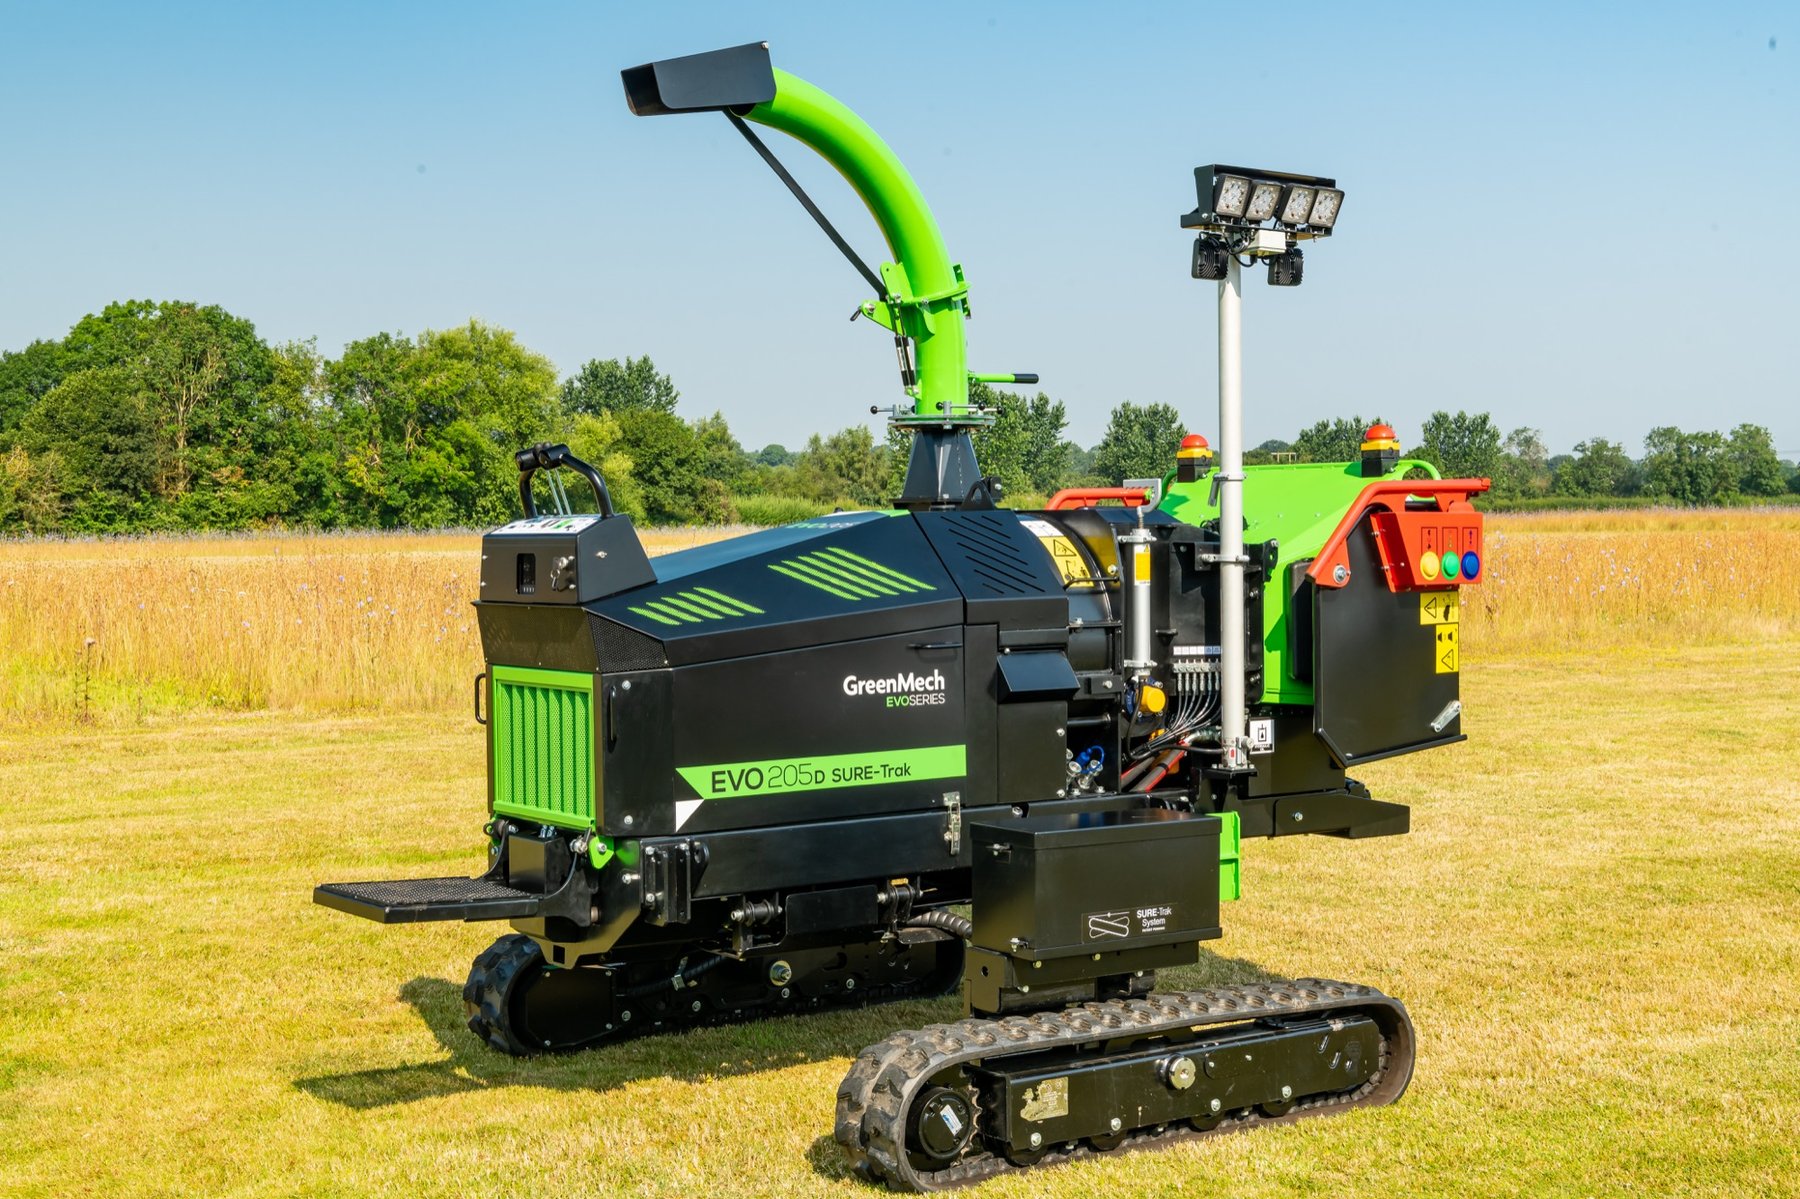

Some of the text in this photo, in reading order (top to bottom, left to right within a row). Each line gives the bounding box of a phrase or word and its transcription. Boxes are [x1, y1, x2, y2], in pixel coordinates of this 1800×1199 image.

[843, 669, 945, 696] GreenMech
[711, 767, 764, 793] EVO
[832, 763, 911, 783] SURE-Trak
[1136, 906, 1172, 919] SURE-Trak
[1142, 918, 1166, 928] System
